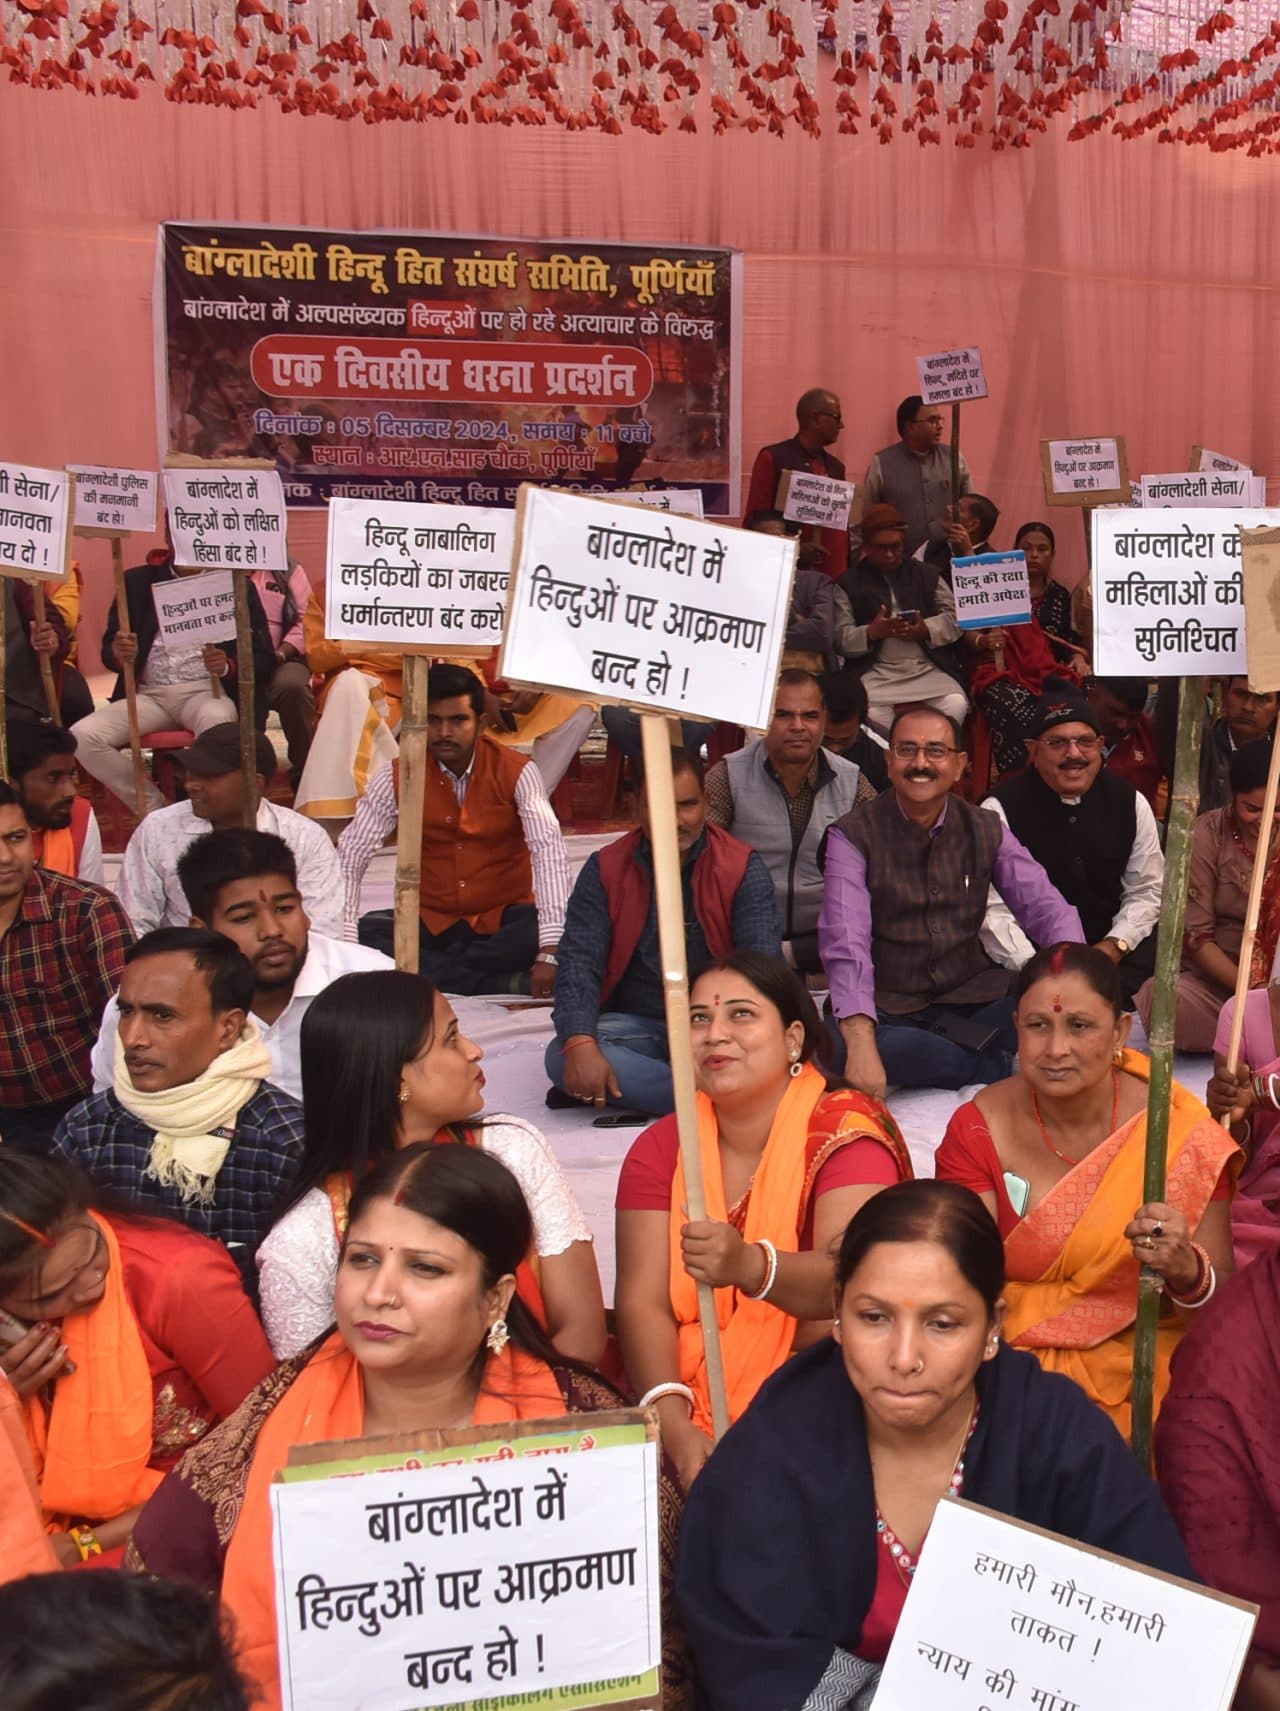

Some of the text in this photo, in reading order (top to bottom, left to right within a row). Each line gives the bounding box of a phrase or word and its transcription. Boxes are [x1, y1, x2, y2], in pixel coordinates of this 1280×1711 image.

[182, 239, 318, 281] बांग्लादेशी
[327, 244, 389, 295] हिन्दू
[395, 248, 444, 286] हित
[453, 251, 518, 288] संघर्ष
[527, 255, 618, 298] समिति,
[183, 295, 265, 322] बांग्लादेश
[272, 297, 291, 322] में
[295, 302, 406, 327] अल्पसंख्यक
[480, 311, 504, 330] पर
[509, 306, 529, 331] हो
[532, 308, 556, 332] रहे
[560, 314, 635, 335] अत्याचार
[640, 311, 659, 336] के
[268, 346, 637, 397] एक दिवसीय धरना प्रदर्शन
[254, 408, 654, 445] दिनांक 05 दिसम्बर 2024, समय 11 बजे
[312, 445, 363, 467] स्थान
[84, 490, 98, 505] की
[186, 475, 243, 501] बांग्लादेश
[247, 475, 259, 500] में
[331, 480, 416, 500] बांग्लादेशी
[468, 481, 499, 502] हित
[1148, 477, 1208, 499] बांग्लादेशी
[174, 506, 280, 536] हिन्दुओं को लक्षित
[364, 518, 497, 556] हिन्दू नाबालिग
[21, 539, 36, 565] दो
[193, 539, 258, 565] हिंसा बंद हो
[588, 522, 727, 584] बांग्लादेश में
[1114, 523, 1215, 559] बांग्लादेश
[340, 560, 453, 596] लड़कियों का
[1105, 571, 1208, 607] महिलाओं
[340, 596, 465, 629] धर्मान्तरण बंद
[529, 564, 766, 654] हिन्दुओं पर आक्रमण
[1134, 618, 1238, 662] सुनिश्चित
[591, 648, 673, 697] बन्द हो
[366, 1467, 569, 1543] बांग्लादेश में
[974, 1551, 1039, 1594] हमारी
[295, 1547, 637, 1637] हिन्दुओं पर आक्रमण
[1010, 1609, 1079, 1653] ताकत
[404, 1625, 518, 1691] बन्द हो
[916, 1640, 973, 1681] न्याय
[985, 1668, 1018, 1700] की
